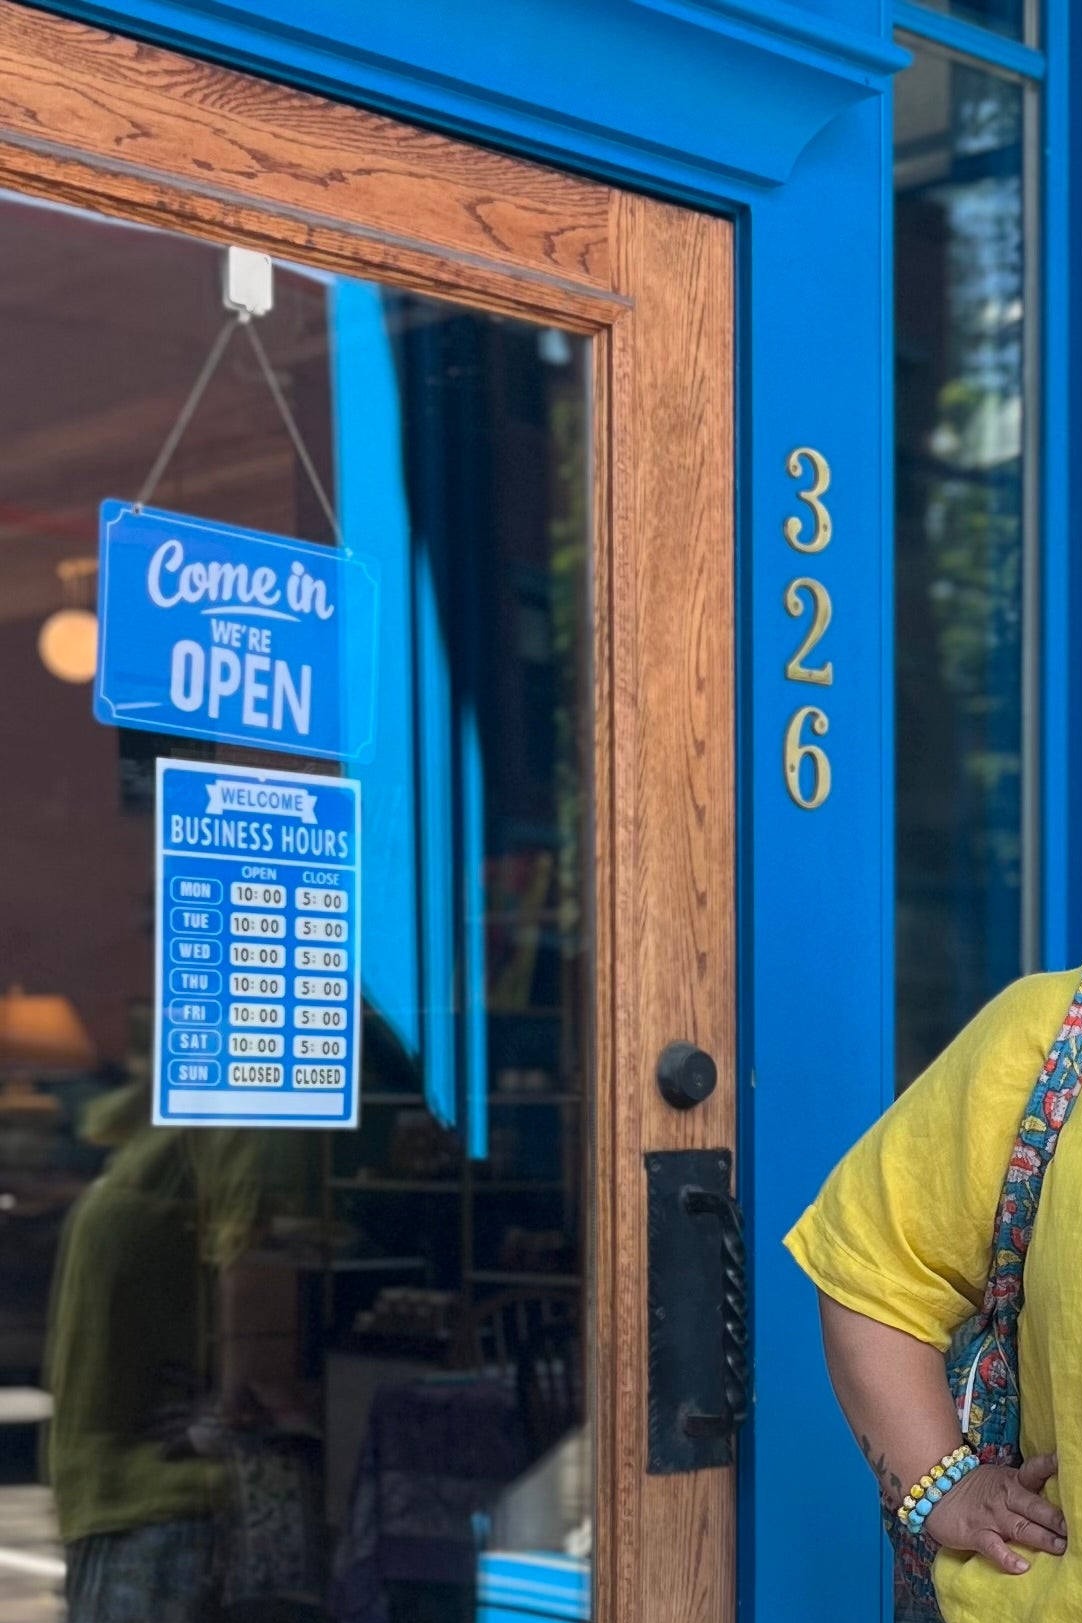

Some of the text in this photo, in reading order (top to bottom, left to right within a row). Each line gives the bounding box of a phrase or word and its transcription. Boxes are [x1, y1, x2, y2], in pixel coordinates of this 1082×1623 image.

[147, 538, 334, 620] Come in
[211, 618, 272, 653] WE'RE
[783, 447, 833, 809] 326
[170, 639, 312, 735] OPEN
[221, 787, 304, 812] WELCOME
[171, 814, 349, 859] BUSINESS HOURS
[241, 866, 340, 886] OPEN CLOSE
[180, 881, 211, 898] MON
[182, 912, 209, 929] TUE
[179, 943, 211, 959] WED
[181, 974, 208, 990] THU
[183, 1005, 206, 1021] FRI
[180, 1033, 208, 1049] SAT
[179, 1065, 341, 1085] SUN CLOSED CLOSED
